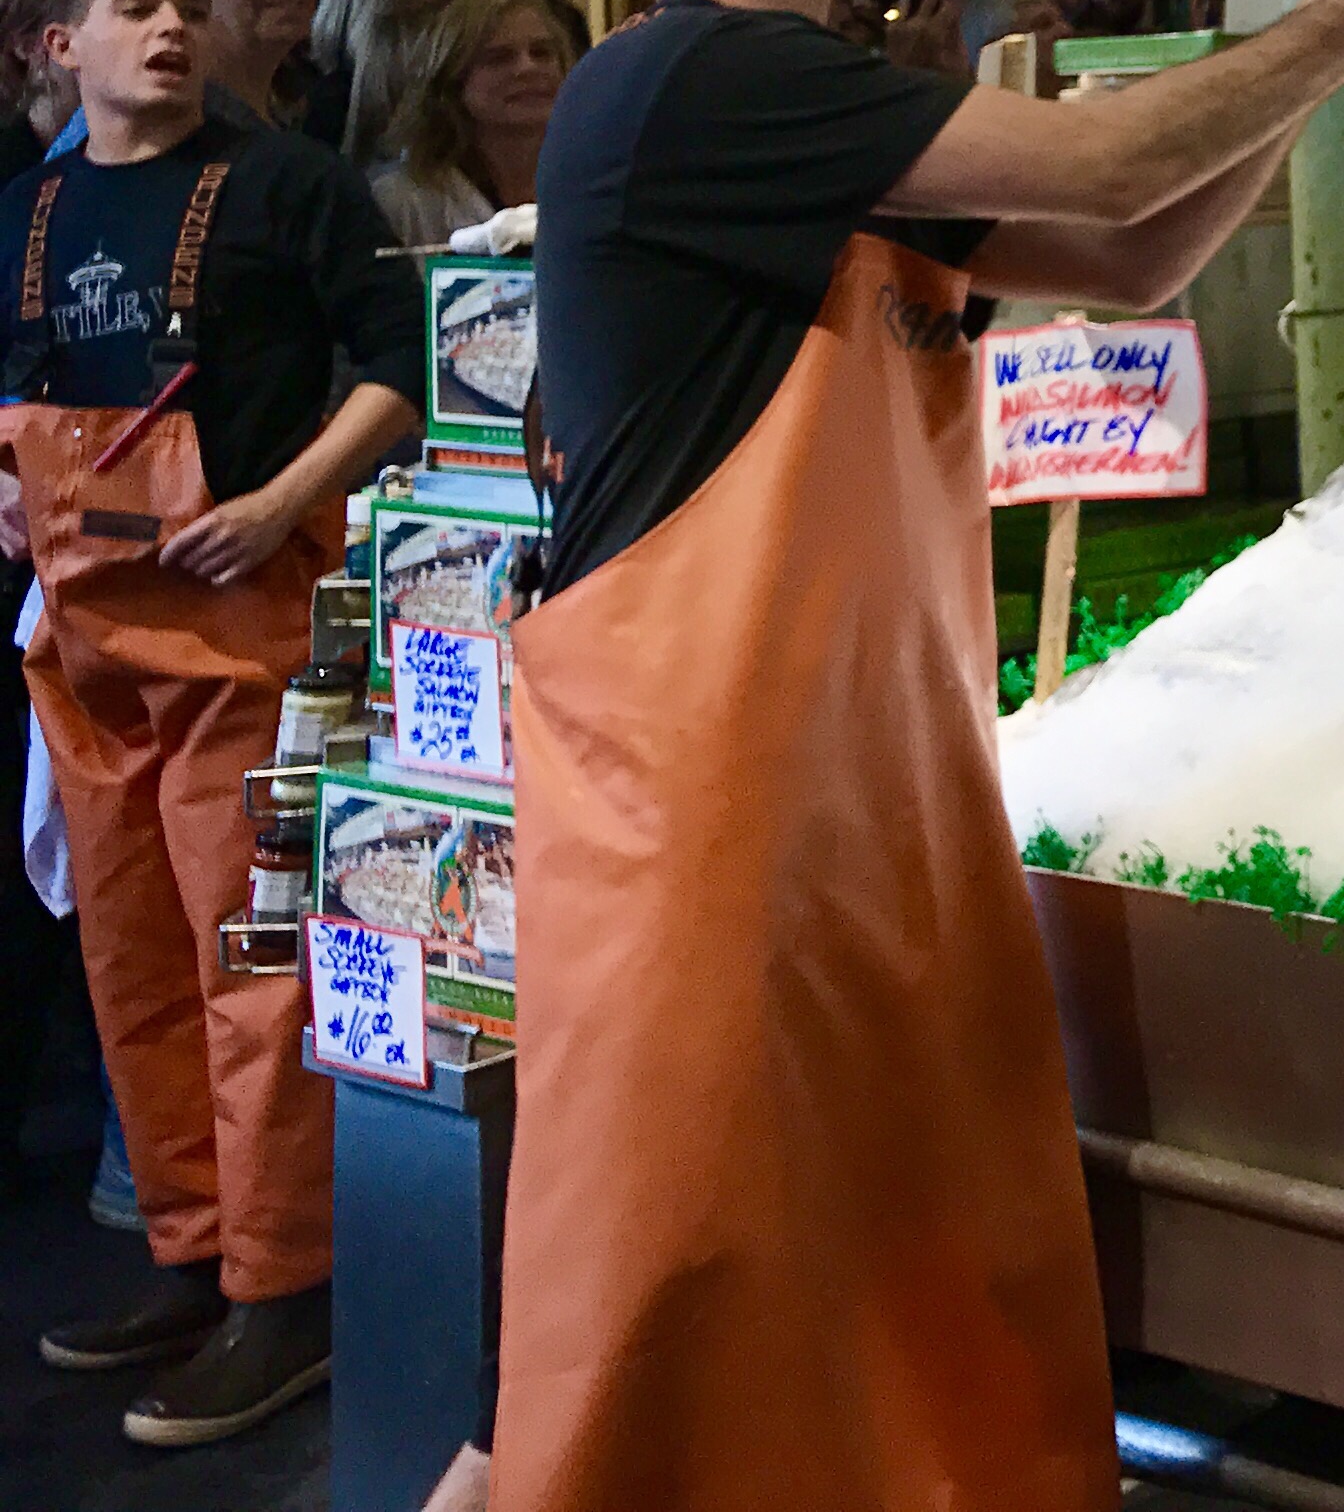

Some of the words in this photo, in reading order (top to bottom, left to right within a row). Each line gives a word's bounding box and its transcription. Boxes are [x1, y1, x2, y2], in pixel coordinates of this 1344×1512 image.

[1092, 339, 1172, 395] ONLY
[405, 628, 474, 664] LARGE
[400, 656, 482, 690] SOCKEYE
[315, 922, 394, 956] SMALL
[318, 945, 407, 985] SOCKEYE
